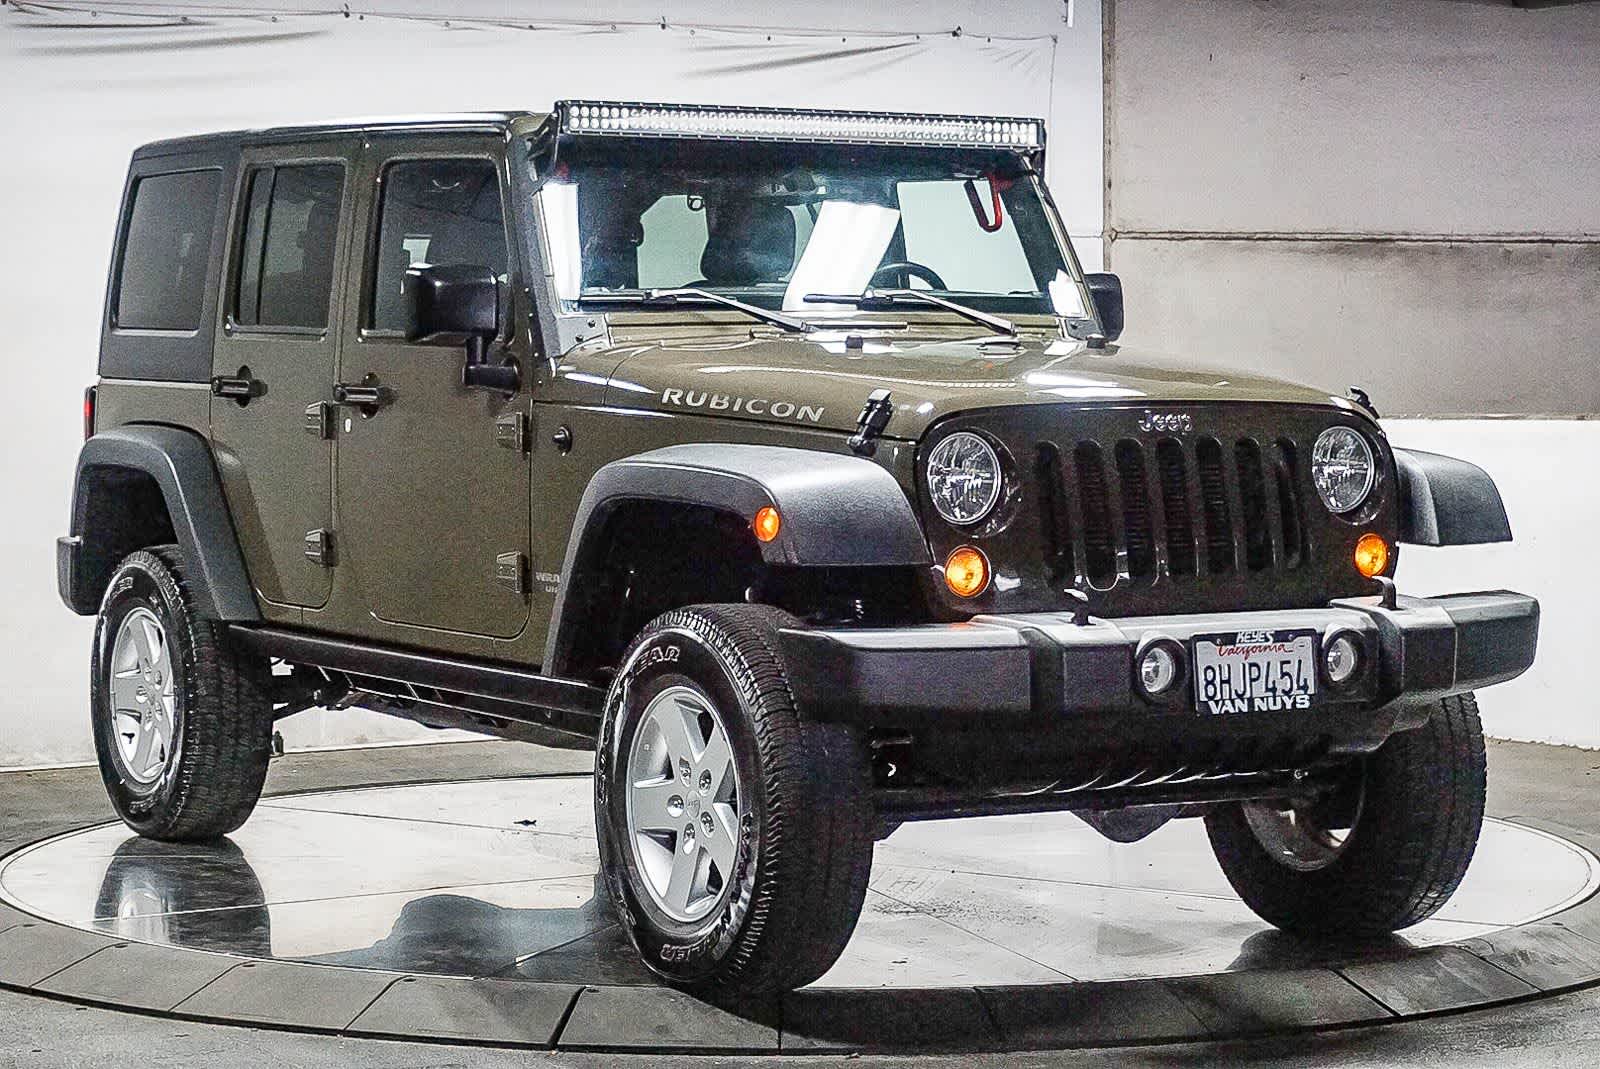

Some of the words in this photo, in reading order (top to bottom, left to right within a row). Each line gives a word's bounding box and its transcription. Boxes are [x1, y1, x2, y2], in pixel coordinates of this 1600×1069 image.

[661, 387, 825, 422] RUBICON
[1138, 409, 1193, 434] Jeep
[1235, 630, 1275, 645] KEYES
[1217, 643, 1294, 661] California
[1203, 659, 1310, 701] 8HJP454
[1208, 698, 1249, 715] VAN
[1254, 694, 1311, 712] NUYS
